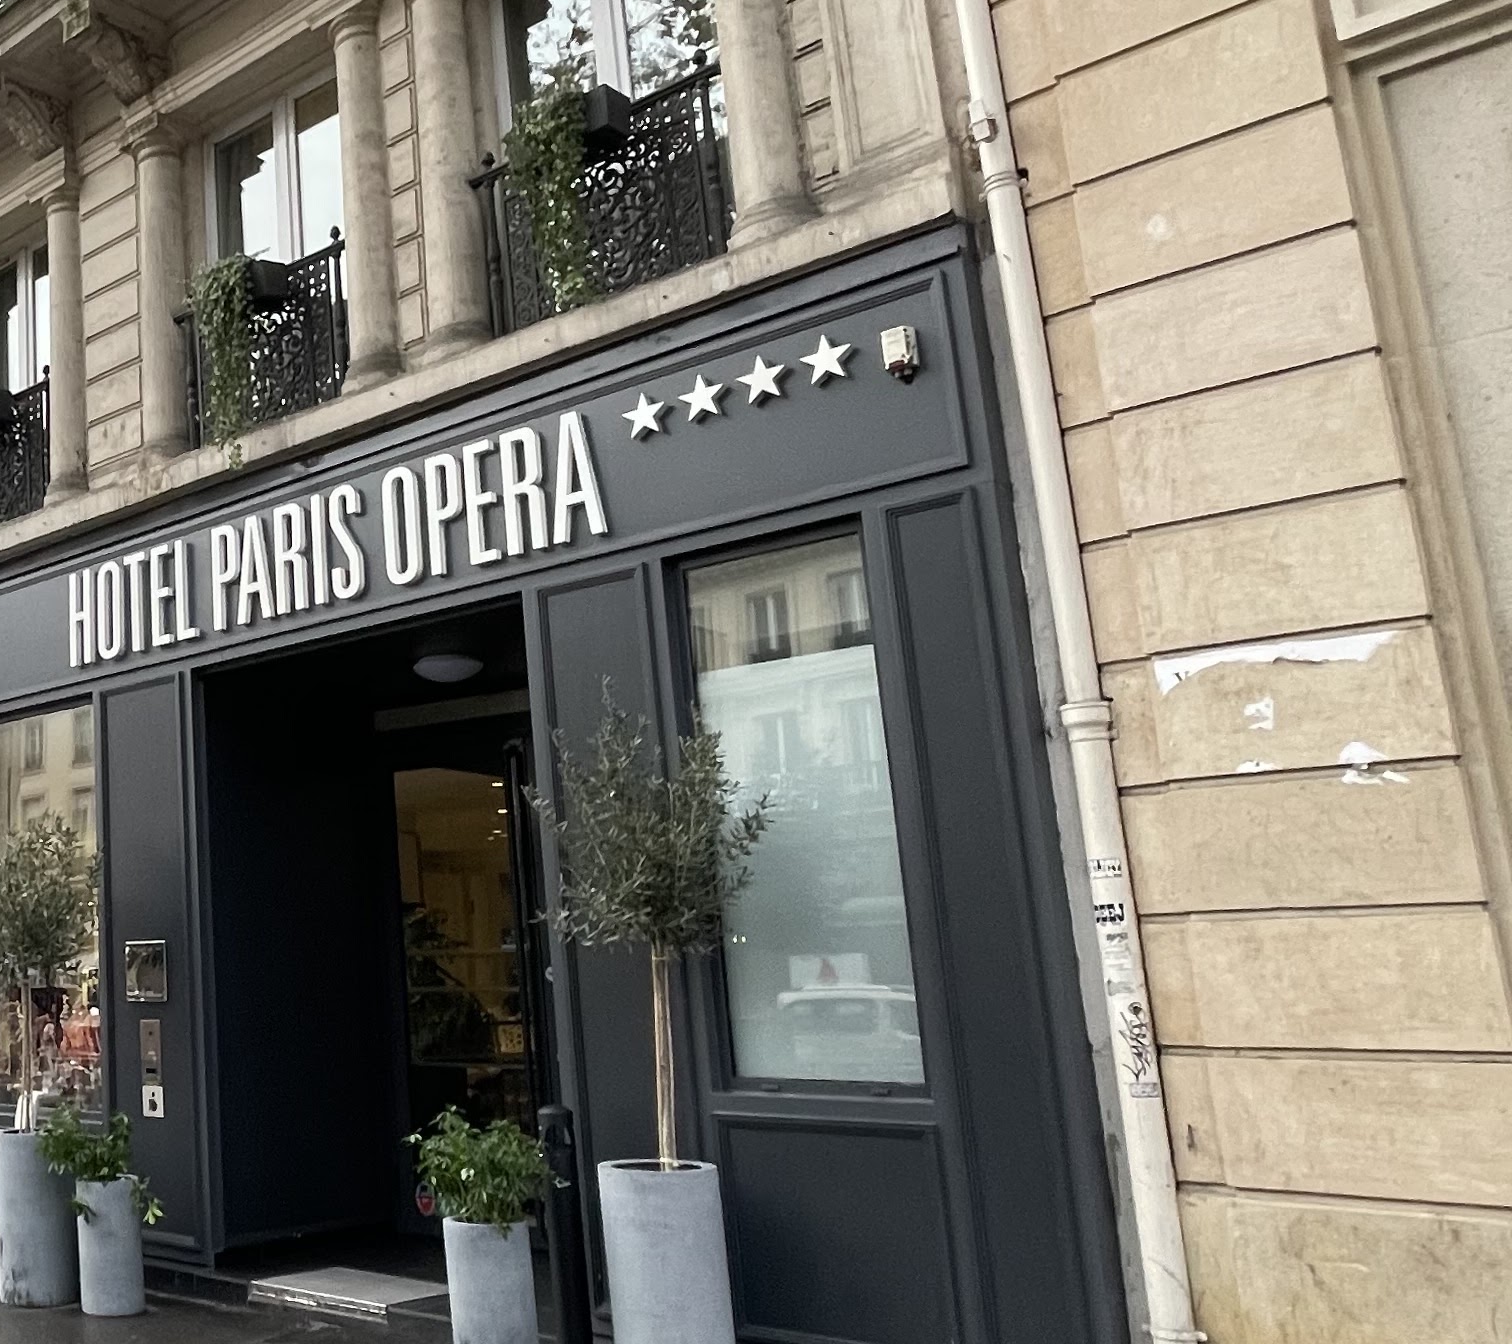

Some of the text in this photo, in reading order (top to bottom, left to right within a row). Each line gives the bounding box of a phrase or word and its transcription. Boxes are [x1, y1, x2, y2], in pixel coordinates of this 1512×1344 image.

[67, 410, 609, 669] HOTEL PARIS OPERA
